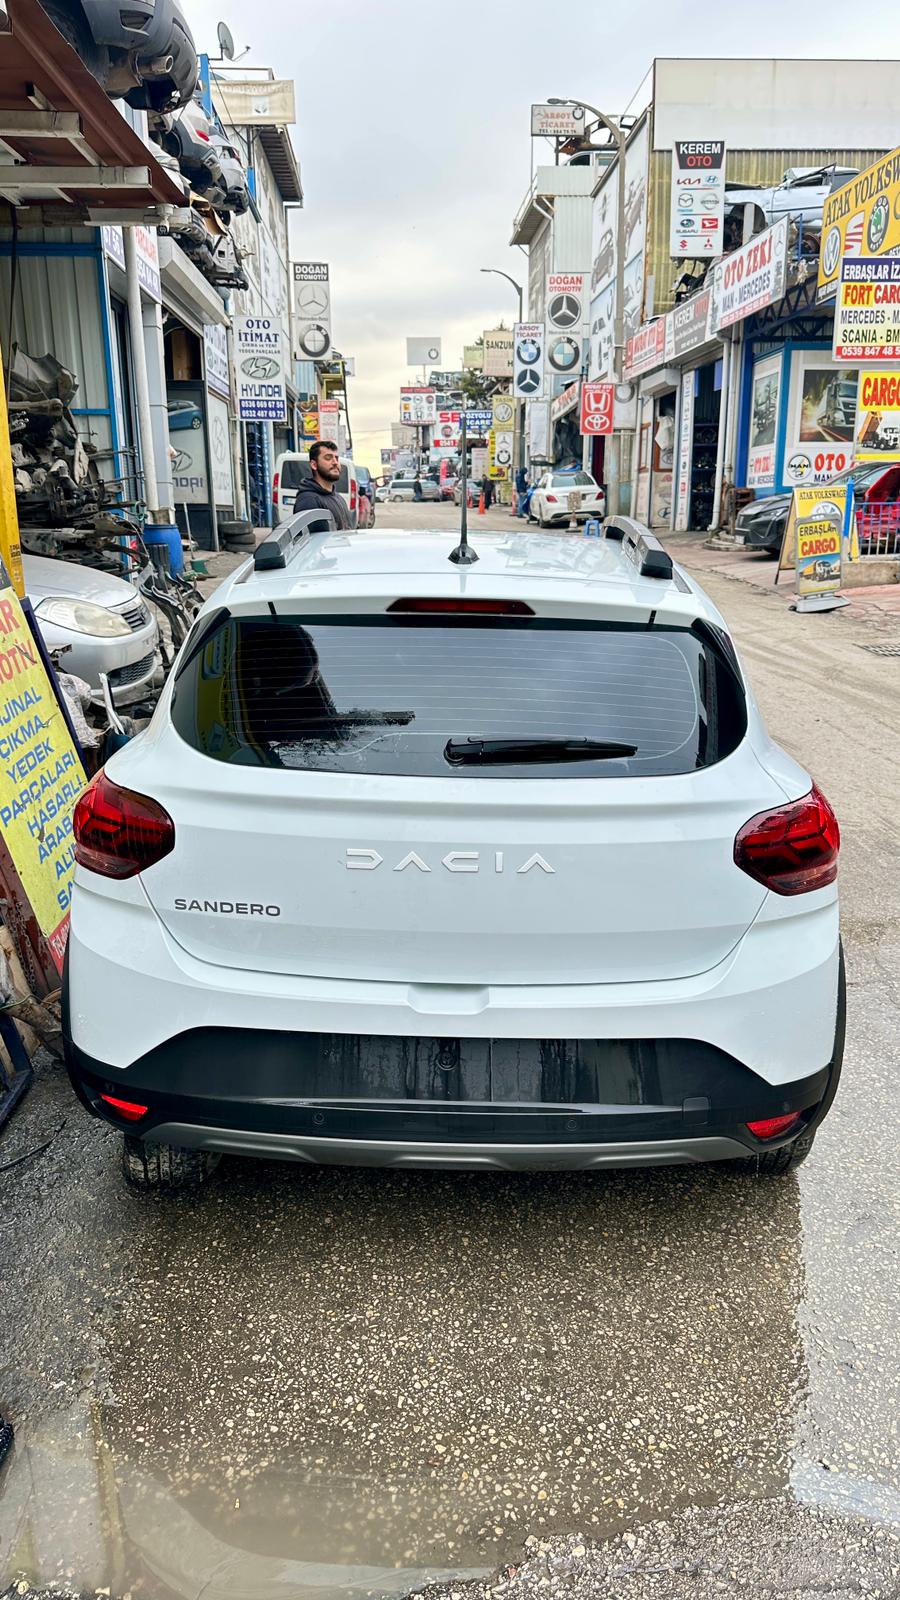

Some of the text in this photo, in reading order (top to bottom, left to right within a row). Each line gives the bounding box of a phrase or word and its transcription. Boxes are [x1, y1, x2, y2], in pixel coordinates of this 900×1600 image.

[680, 143, 720, 154] KEREM
[687, 156, 712, 167] OTO
[825, 187, 851, 228] ATAK
[295, 263, 328, 274] DOĞAN
[724, 256, 744, 290] OTO
[844, 265, 889, 282] ERBAŞLAR
[549, 276, 582, 285] DOĞAN
[739, 270, 771, 304] MERCEDES
[844, 285, 873, 305] FORT
[246, 319, 271, 329] OTO
[840, 310, 885, 324] MERCEDES
[238, 330, 280, 343] İTİMAT
[842, 329, 877, 343] SCANIA
[841, 346, 863, 355] 0539
[864, 346, 881, 355] 847
[882, 346, 893, 355] 48
[241, 384, 282, 397] HYUNDAI
[814, 453, 846, 471] OTO
[799, 491, 814, 500] ATAK
[801, 537, 836, 556] CARGO
[0, 715, 44, 763] ÇIKMA
[6, 737, 55, 784] YEDEK
[0, 749, 78, 828] PARÇALARI
[27, 774, 84, 838] HASARLI
[345, 847, 556, 874] DACIA
[174, 898, 281, 917] SANDERO
